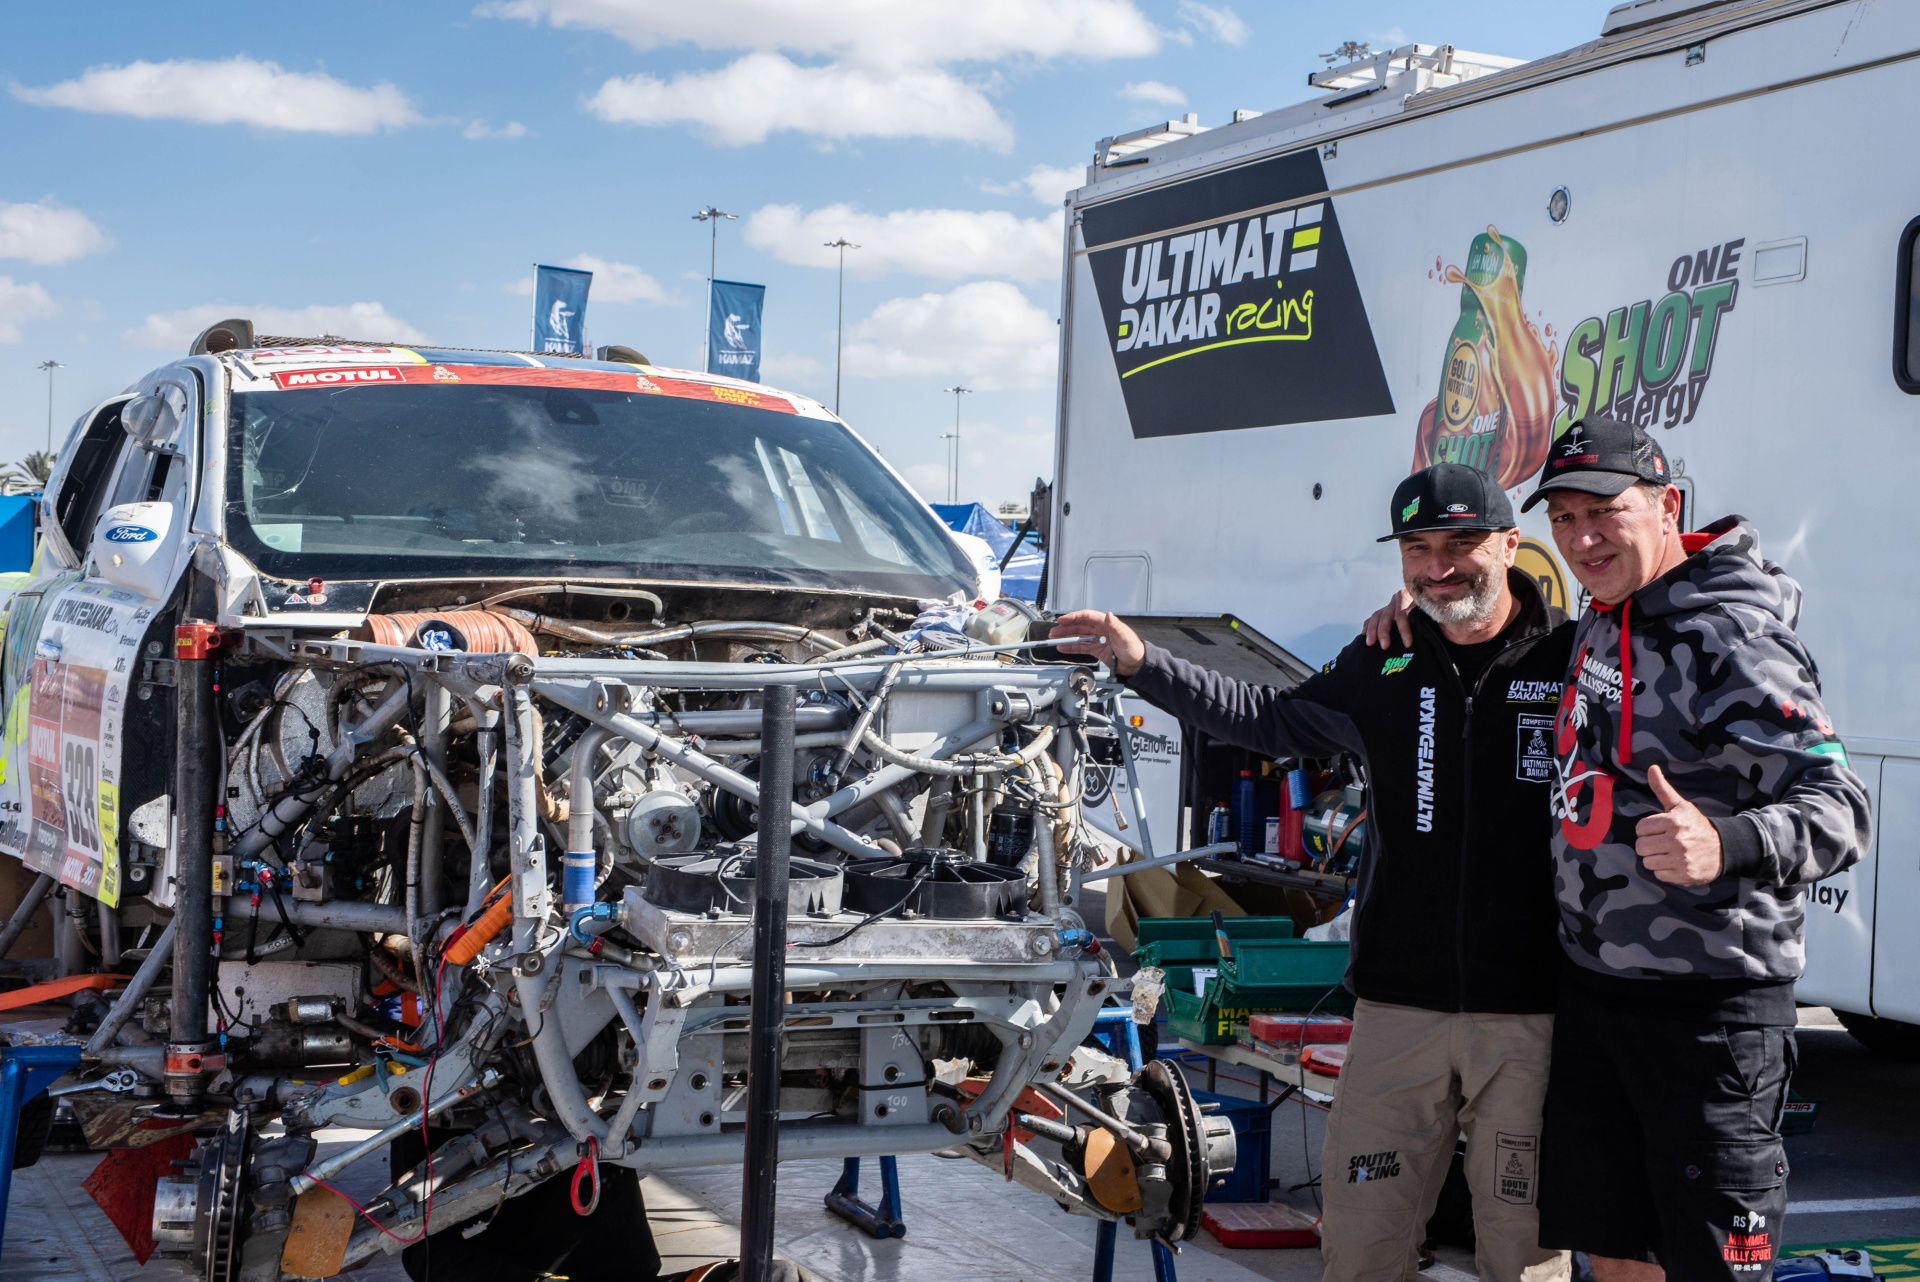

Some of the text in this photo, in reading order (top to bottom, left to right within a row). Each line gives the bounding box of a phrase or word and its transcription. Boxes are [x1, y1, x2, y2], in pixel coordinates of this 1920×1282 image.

[1122, 203, 1324, 304] ULTIMATE
[1667, 237, 1745, 291] ONE
[1117, 279, 1314, 352] DAKAR racing
[1551, 278, 1739, 440] SHOT
[287, 369, 397, 386] MOTUL
[1451, 357, 1476, 383] GOLD
[1446, 377, 1476, 400] NUTRITION
[1604, 378, 1707, 430] nergy
[1472, 411, 1500, 433] ONE
[111, 527, 148, 540] Ford
[1381, 657, 1412, 675] SHOT
[1582, 655, 1640, 692] AMMOT
[1506, 691, 1546, 701] DAKAR
[1509, 680, 1563, 694] ULTIMAT
[1416, 686, 1436, 832] ULTIMATEDAKAR
[1522, 759, 1553, 769] ULTIMATE
[1526, 768, 1549, 777] DAKAR
[64, 741, 99, 853] 328
[1806, 881, 1849, 914] lay
[887, 1094, 908, 1107] 100
[1349, 1151, 1398, 1170] SOUTH
[1501, 1179, 1528, 1189] SOUTH
[1501, 1188, 1527, 1199] RACING
[1733, 1215, 1747, 1228] RS
[1723, 1247, 1772, 1263] RALLY SPORT
